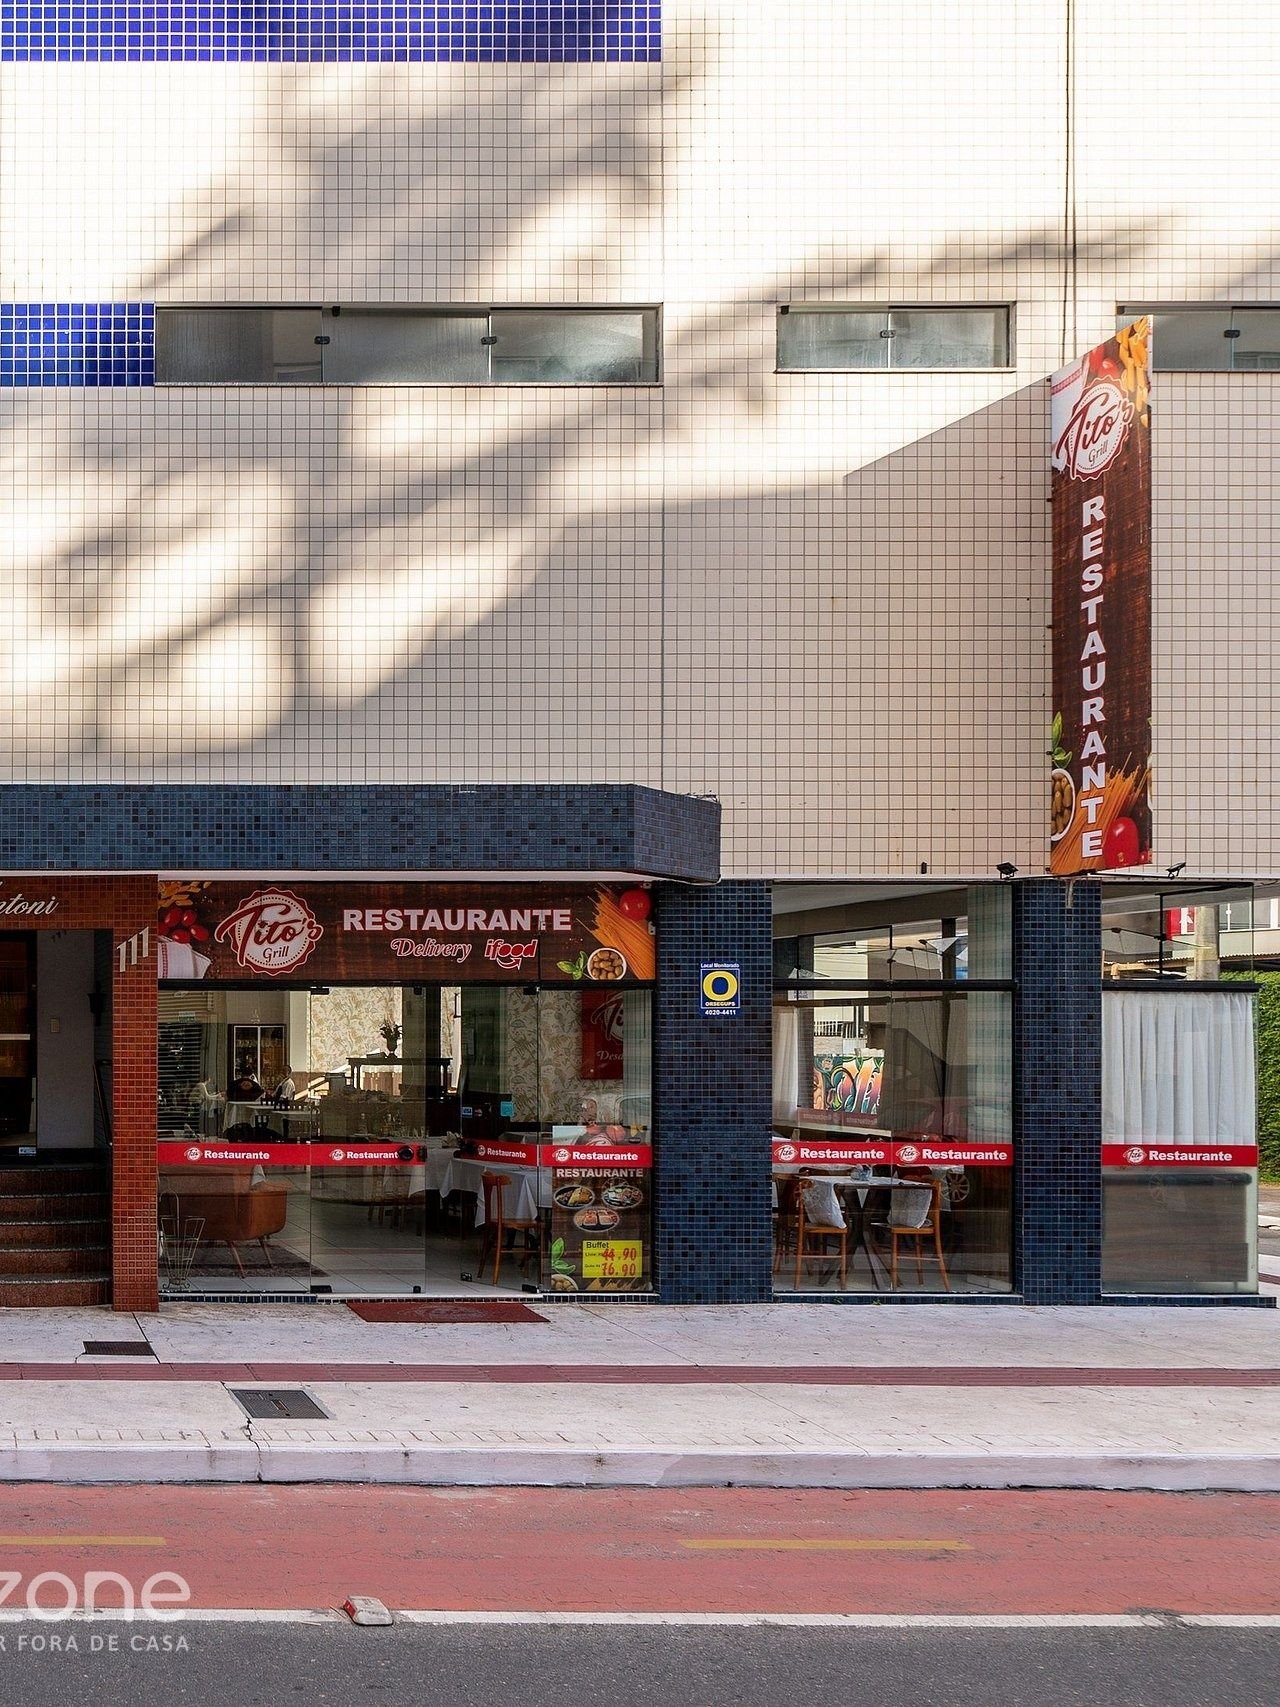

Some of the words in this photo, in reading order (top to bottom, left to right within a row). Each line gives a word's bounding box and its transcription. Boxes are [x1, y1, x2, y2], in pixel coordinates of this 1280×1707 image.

[1088, 440, 1108, 467] Grill
[1079, 495, 1107, 858] RESTAURANTE
[343, 909, 572, 931] RESTAURANTE
[214, 902, 324, 967] Tito's
[116, 926, 149, 973] 111
[262, 945, 291, 964] Grill
[390, 938, 472, 963] Delivery
[204, 1150, 270, 1160] Restaurante
[346, 1151, 400, 1160] Restaurant
[487, 1147, 527, 1159] Restaurante
[572, 1151, 639, 1161] Restaurante
[800, 1147, 885, 1160] Restaurante
[922, 1148, 1008, 1161] Restaurante
[1149, 1150, 1233, 1161] Restaurante
[556, 1168, 644, 1178] RESTAURANTE
[586, 1241, 609, 1249] Buffet
